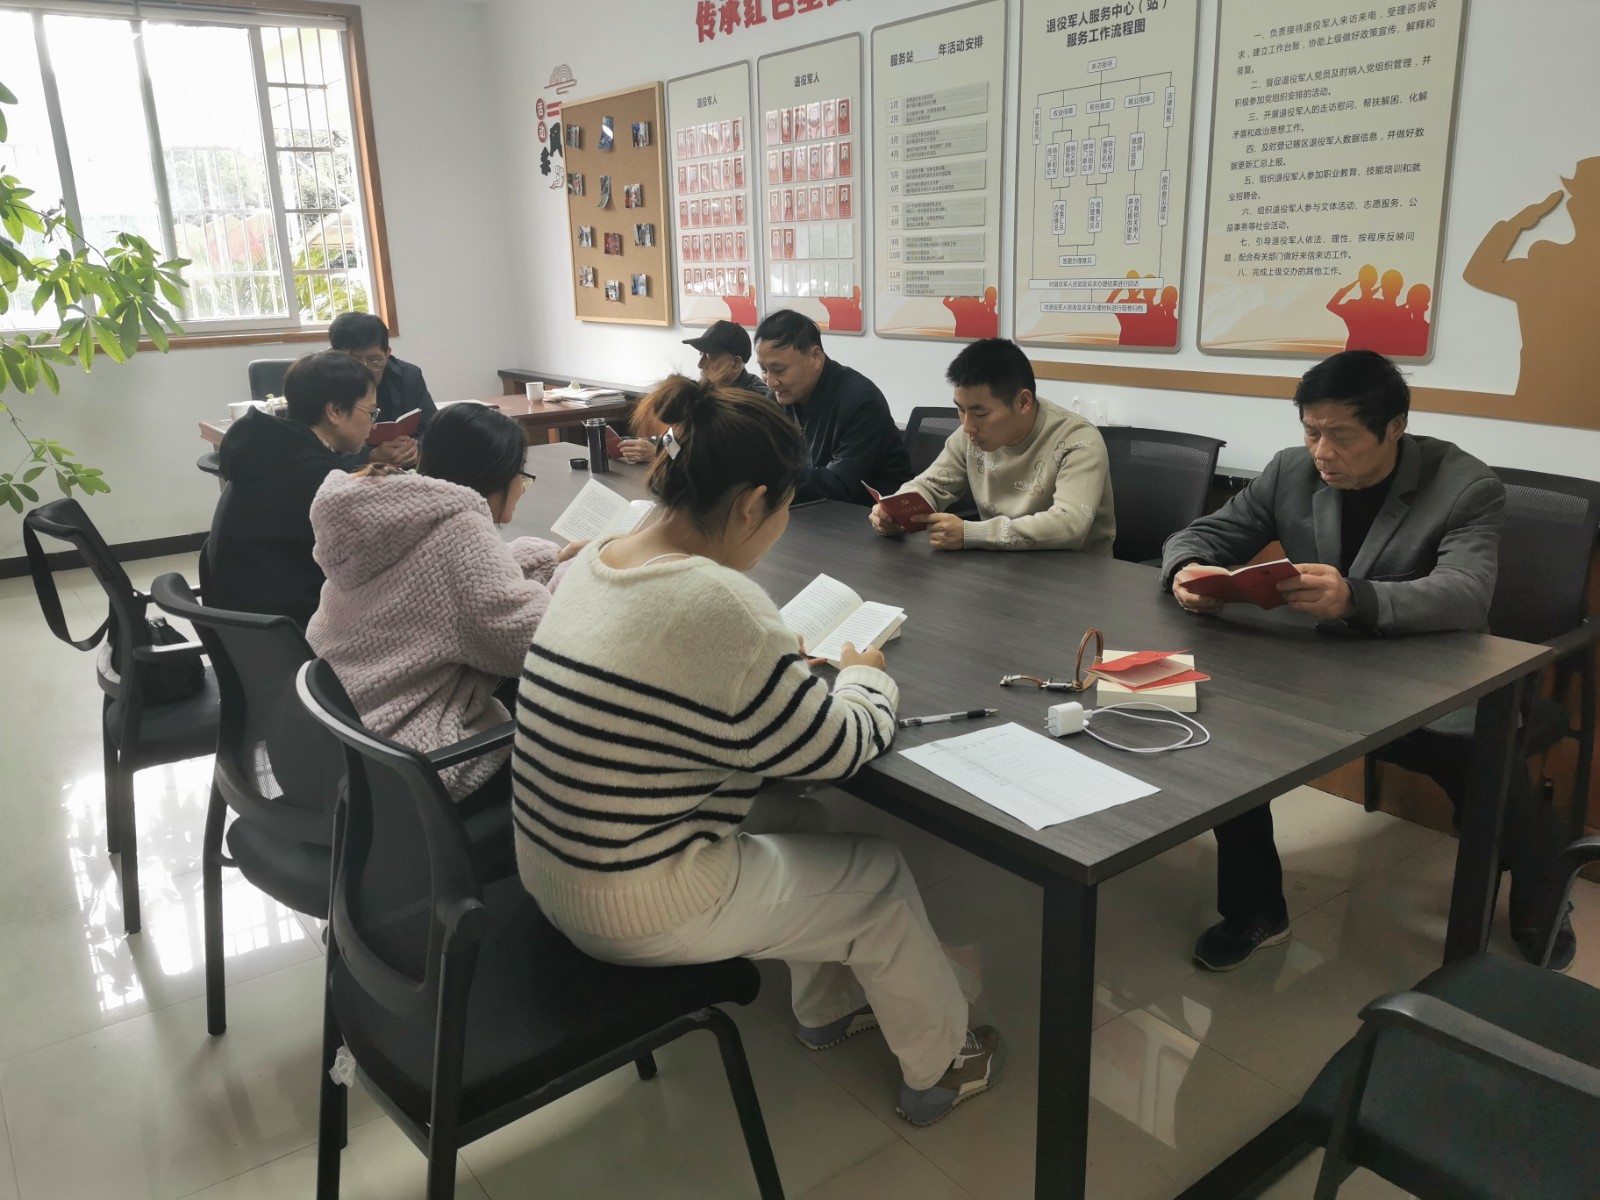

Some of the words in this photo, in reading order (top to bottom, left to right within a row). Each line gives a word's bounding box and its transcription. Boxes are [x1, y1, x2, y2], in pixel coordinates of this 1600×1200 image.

[695, 0, 851, 43] 传承红
[1066, 18, 1146, 48] 服务工作流程图
[890, 50, 914, 67] 服务站
[938, 34, 984, 56] 年活动安排
[794, 72, 820, 88] 退役军人
[696, 94, 718, 109] 退役军人
[1234, 87, 1333, 108] 积极参加党组织安排的活动。
[1232, 123, 1305, 140] 矛盾和政治思想工作。
[1230, 157, 1286, 171] 据更新汇总上报。
[1228, 191, 1261, 202] 业招聘会。
[1226, 221, 1290, 233] 益事务等社会活动。
[1237, 266, 1342, 278] 八、完成上级交办的其他工作。
